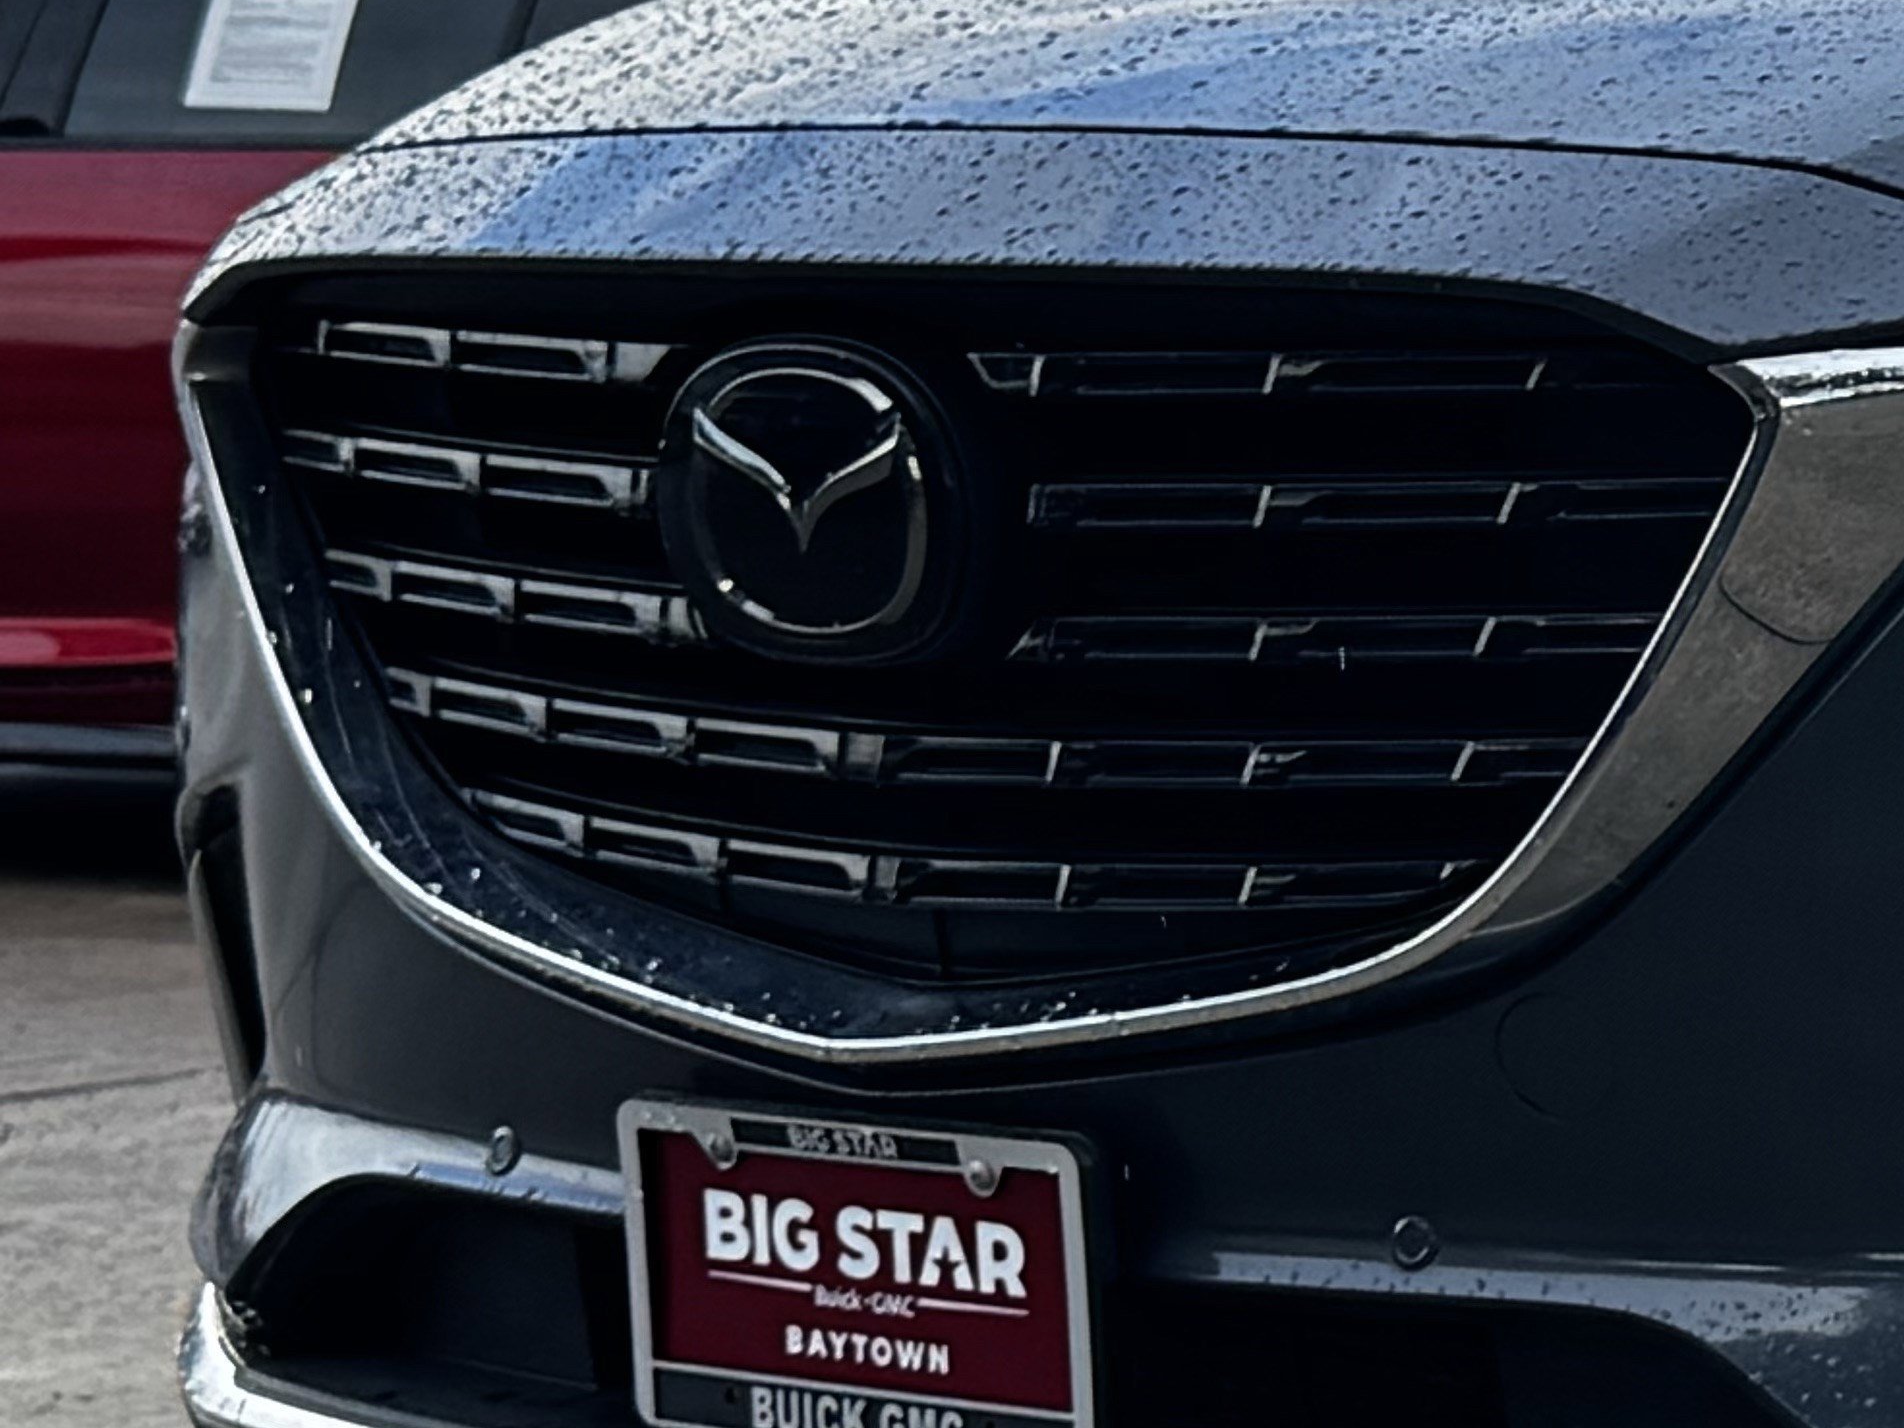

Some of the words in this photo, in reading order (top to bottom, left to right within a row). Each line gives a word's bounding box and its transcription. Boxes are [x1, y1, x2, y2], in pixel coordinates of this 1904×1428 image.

[786, 1123, 830, 1153] BIG
[832, 1129, 898, 1158] STAR
[703, 1187, 820, 1272] BIG
[835, 1204, 1027, 1299] STAR
[870, 1290, 916, 1319] GMC
[784, 1324, 950, 1376] BAYTOWN
